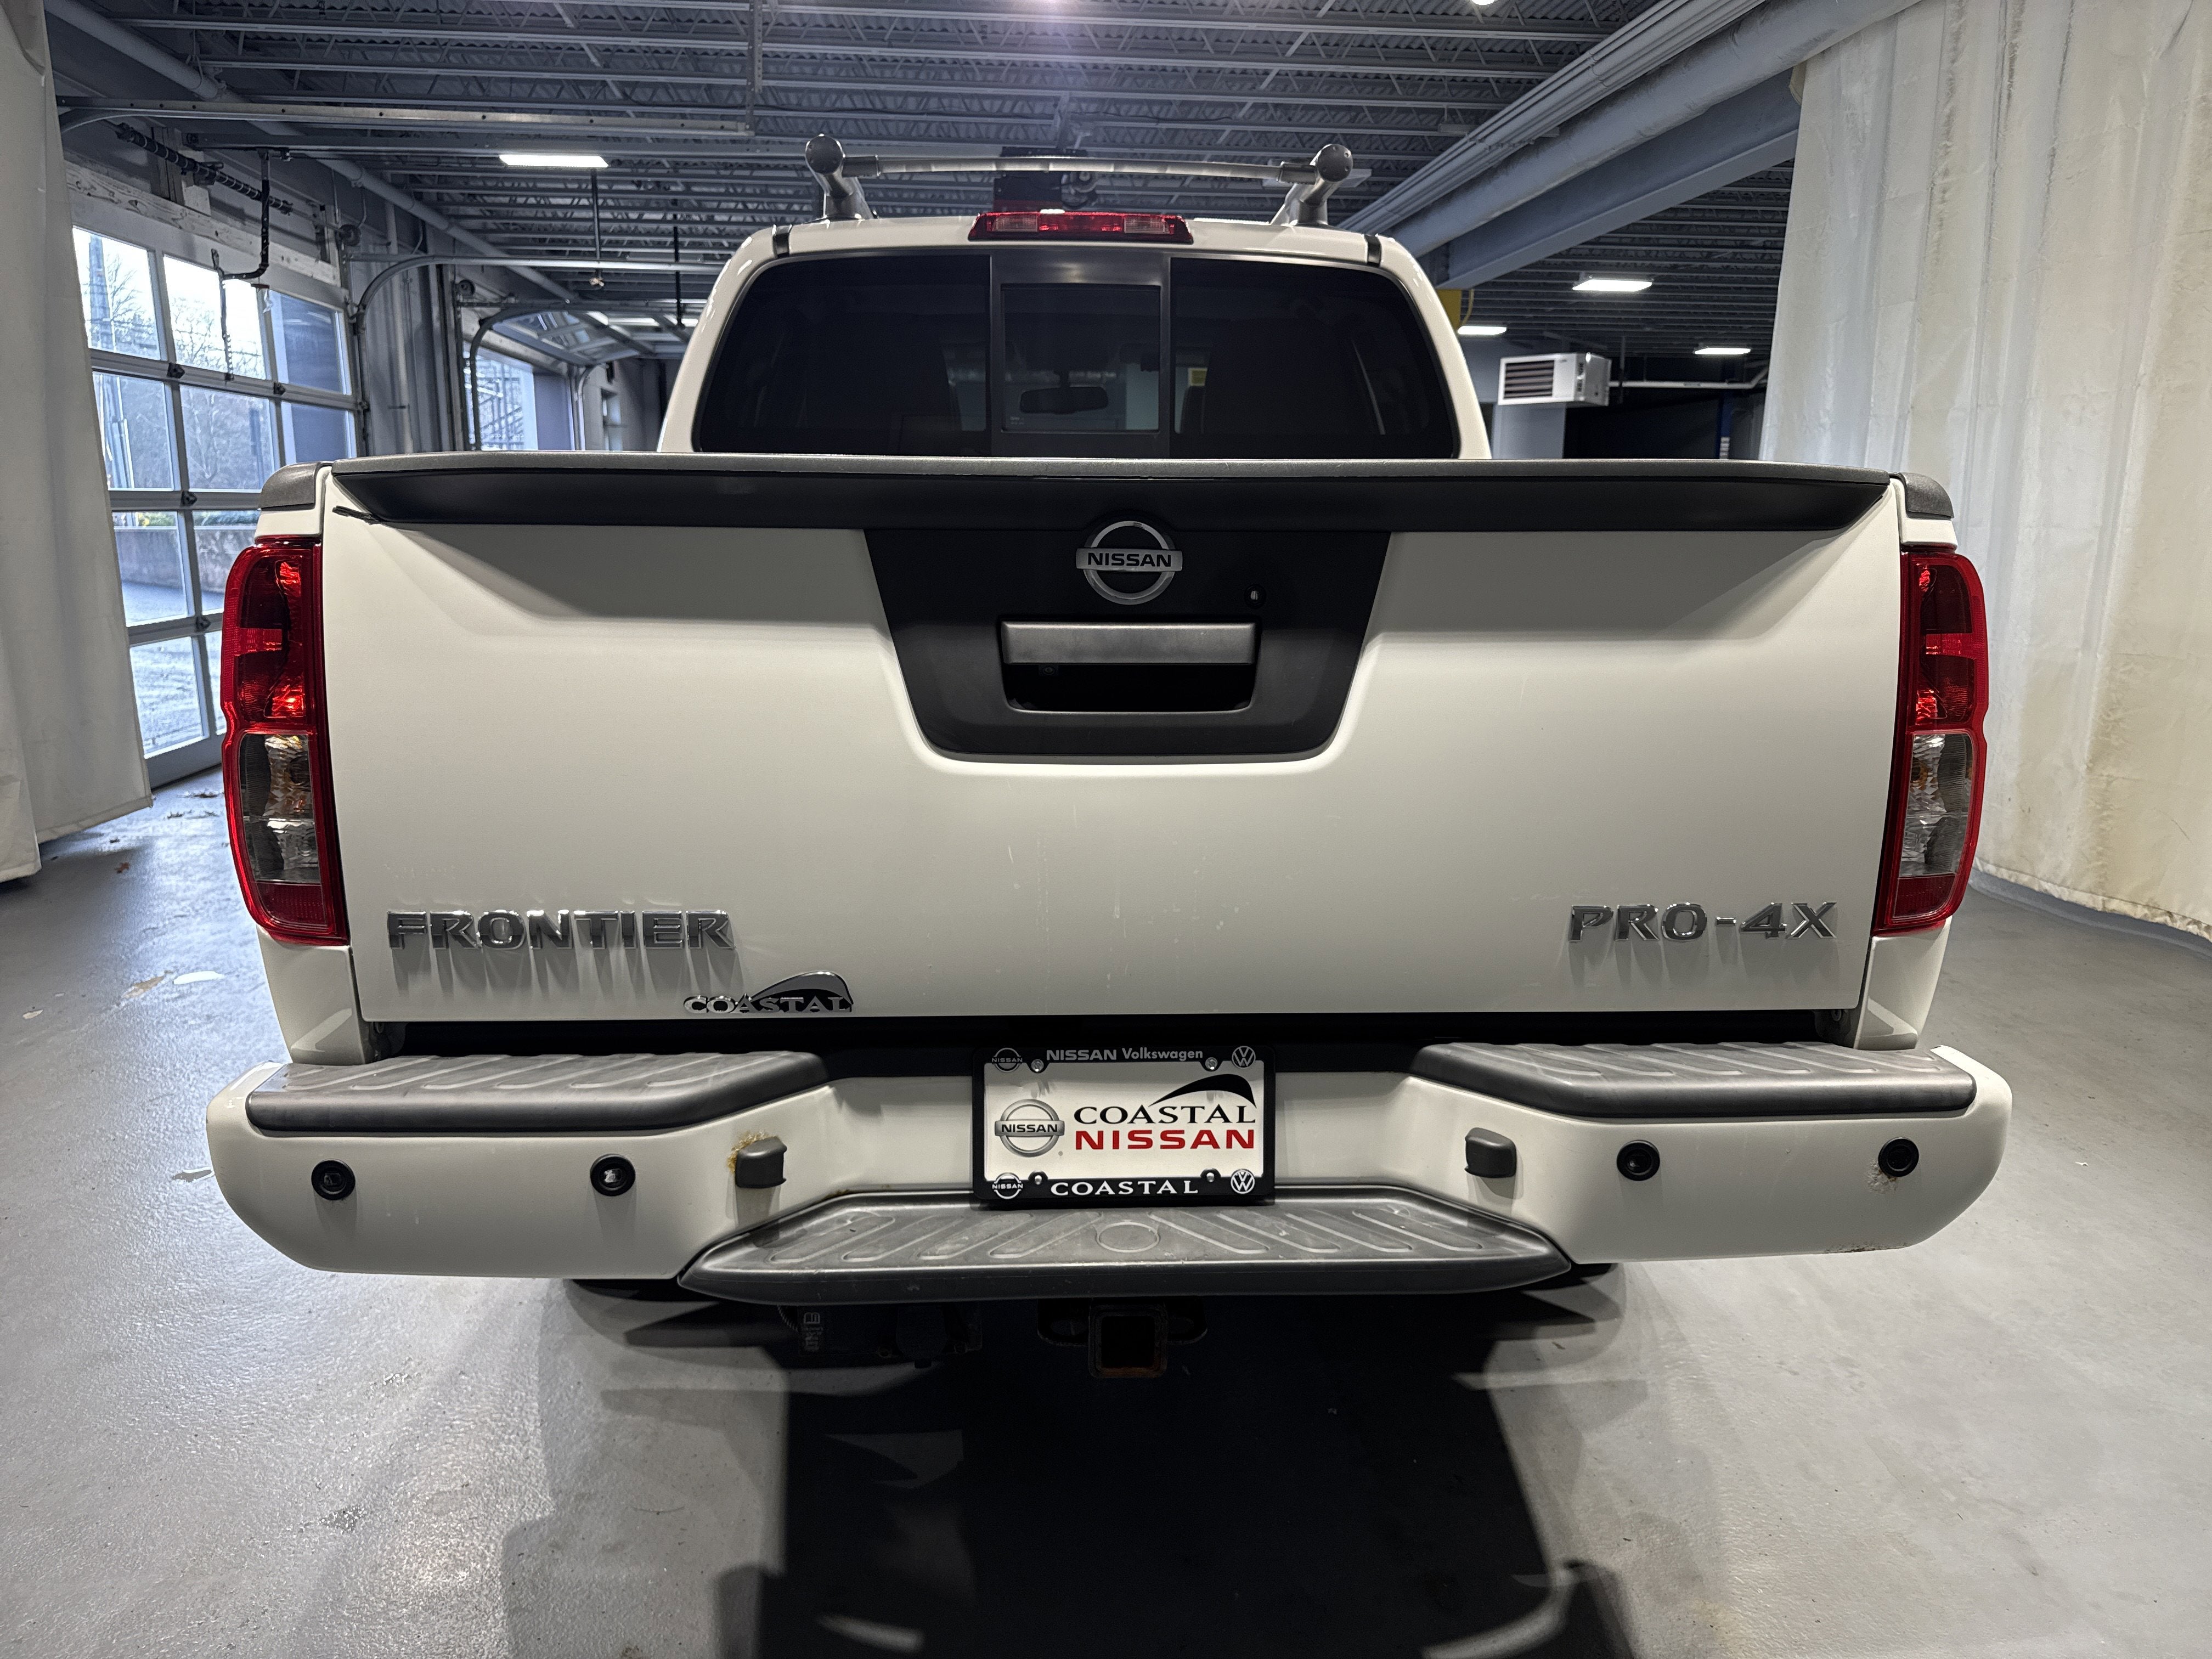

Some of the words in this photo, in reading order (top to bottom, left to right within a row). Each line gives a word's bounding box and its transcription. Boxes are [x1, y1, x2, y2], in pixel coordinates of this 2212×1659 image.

[1088, 552, 1171, 567] NISSAN
[387, 910, 736, 950] FRONTIER
[1568, 901, 1838, 942] PRO-4X
[684, 994, 852, 1014] COASTAL
[1046, 1049, 1117, 1060] NISSAN
[1122, 1047, 1203, 1062] Volkswagen
[1074, 1104, 1256, 1125] COASTAL
[1001, 1123, 1058, 1133] NISSAN
[1075, 1129, 1255, 1150] NISSAN
[1051, 1180, 1199, 1196] COASTAL
